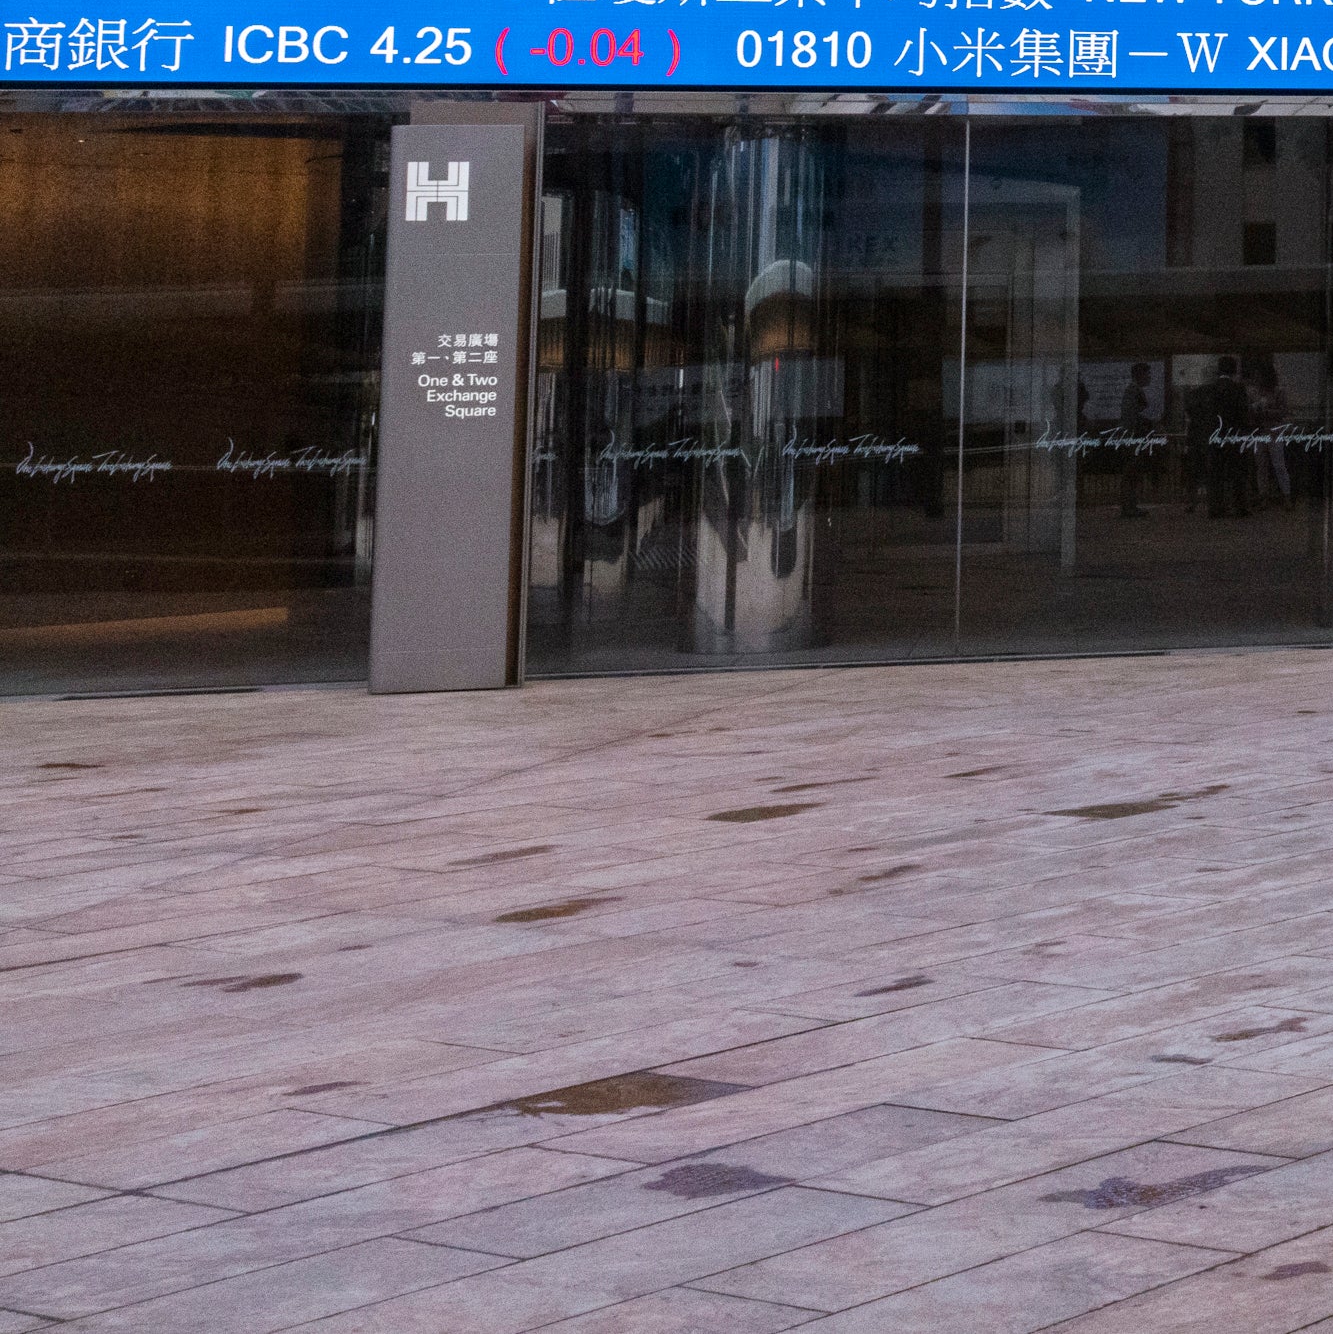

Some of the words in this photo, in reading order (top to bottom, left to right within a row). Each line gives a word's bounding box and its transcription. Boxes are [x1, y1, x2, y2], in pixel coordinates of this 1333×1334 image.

[4, 17, 194, 71] 商銀行
[224, 25, 348, 64] ICBC
[370, 26, 471, 65] 4.25
[737, 30, 871, 68] 01810
[418, 373, 448, 387] One
[452, 373, 465, 387] &
[467, 373, 498, 386] Two
[426, 389, 497, 404] Exchange
[444, 404, 497, 420] Square
